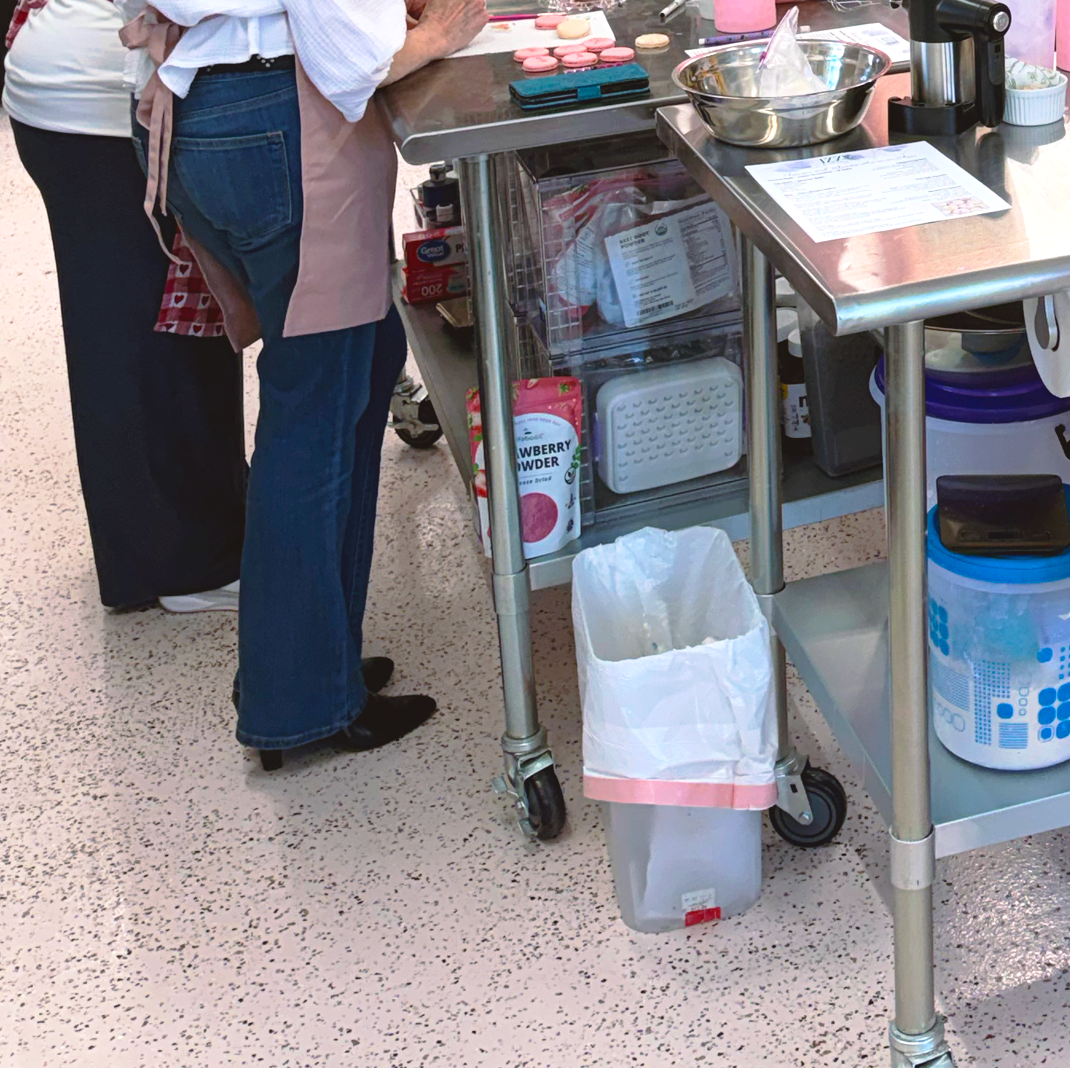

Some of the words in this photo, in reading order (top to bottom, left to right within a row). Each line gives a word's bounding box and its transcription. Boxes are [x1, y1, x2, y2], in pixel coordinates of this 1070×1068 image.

[420, 244, 445, 255] Great
[421, 284, 444, 296] 200
[516, 439, 572, 460] WBERRY
[516, 456, 560, 472] WDER
